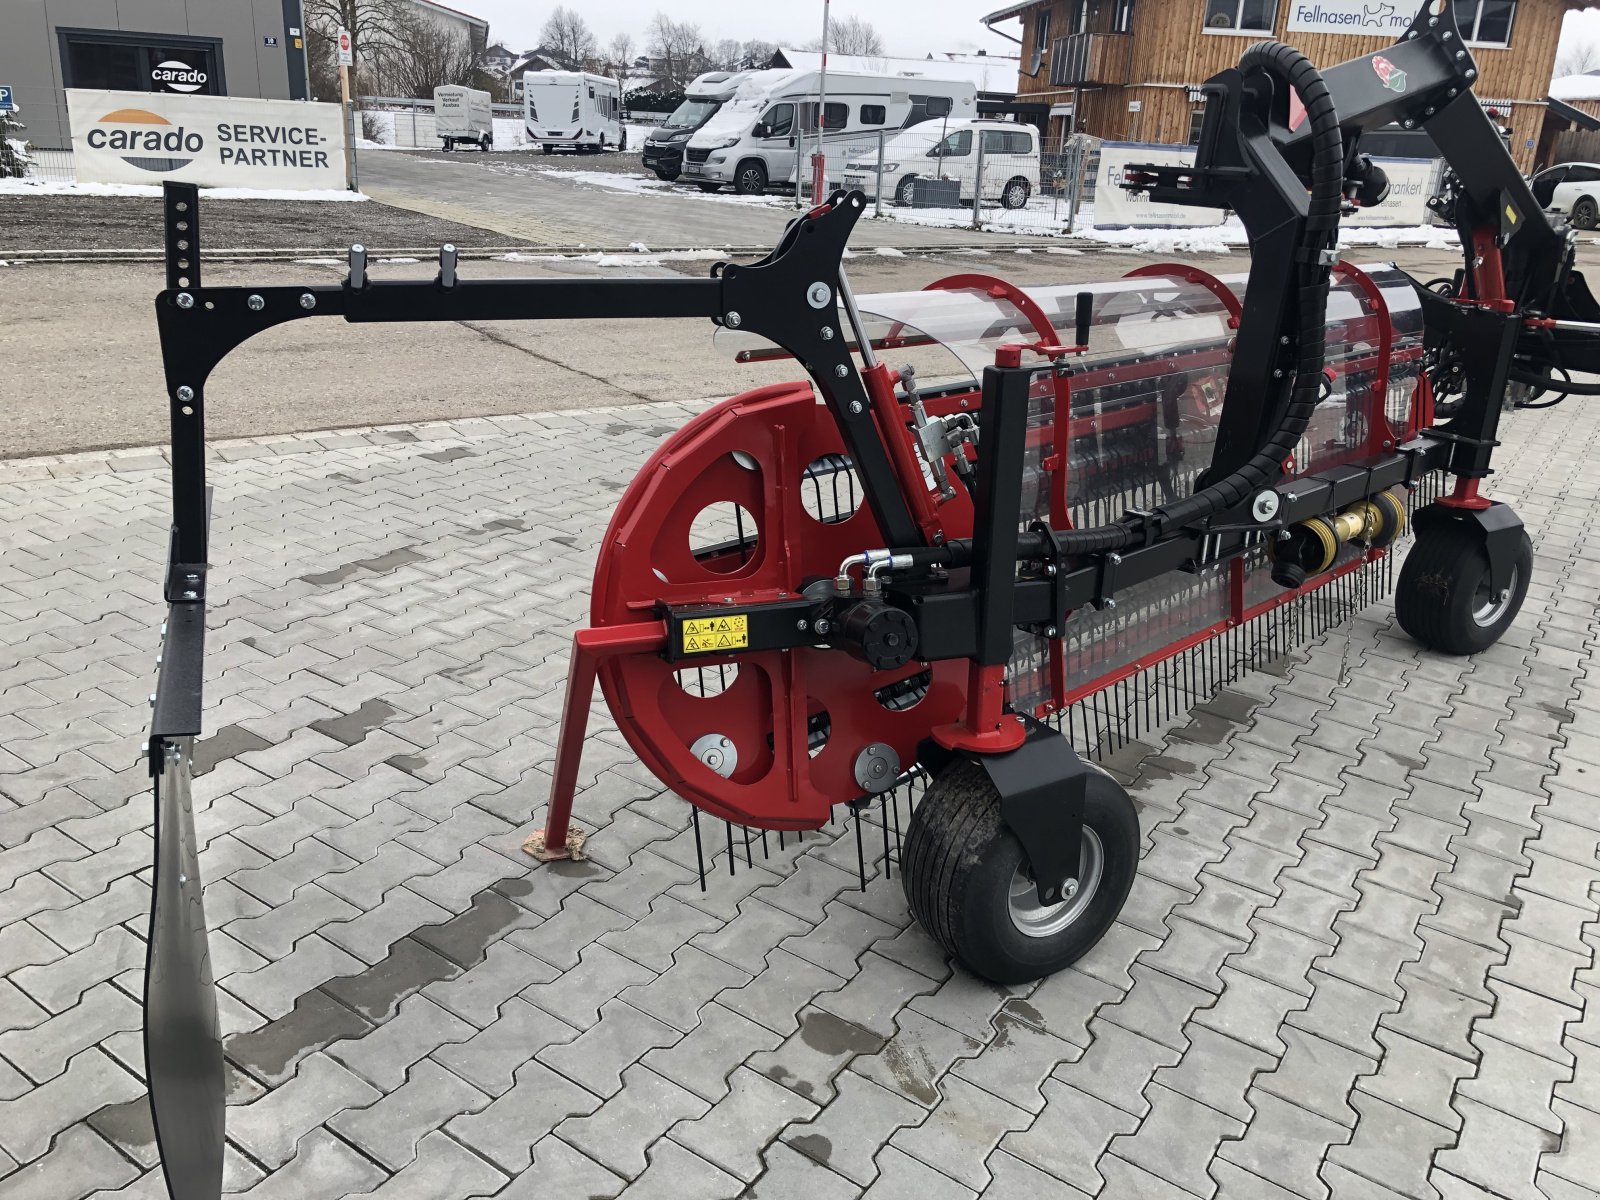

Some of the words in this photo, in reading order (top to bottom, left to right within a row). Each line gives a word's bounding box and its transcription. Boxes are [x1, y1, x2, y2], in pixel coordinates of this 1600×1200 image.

[1296, 5, 1361, 25] Fellnasen
[1390, 10, 1416, 27] mo
[151, 69, 208, 83] carado
[87, 126, 204, 153] carado
[217, 123, 327, 146] SERVICE-
[219, 147, 330, 169] PARTNER
